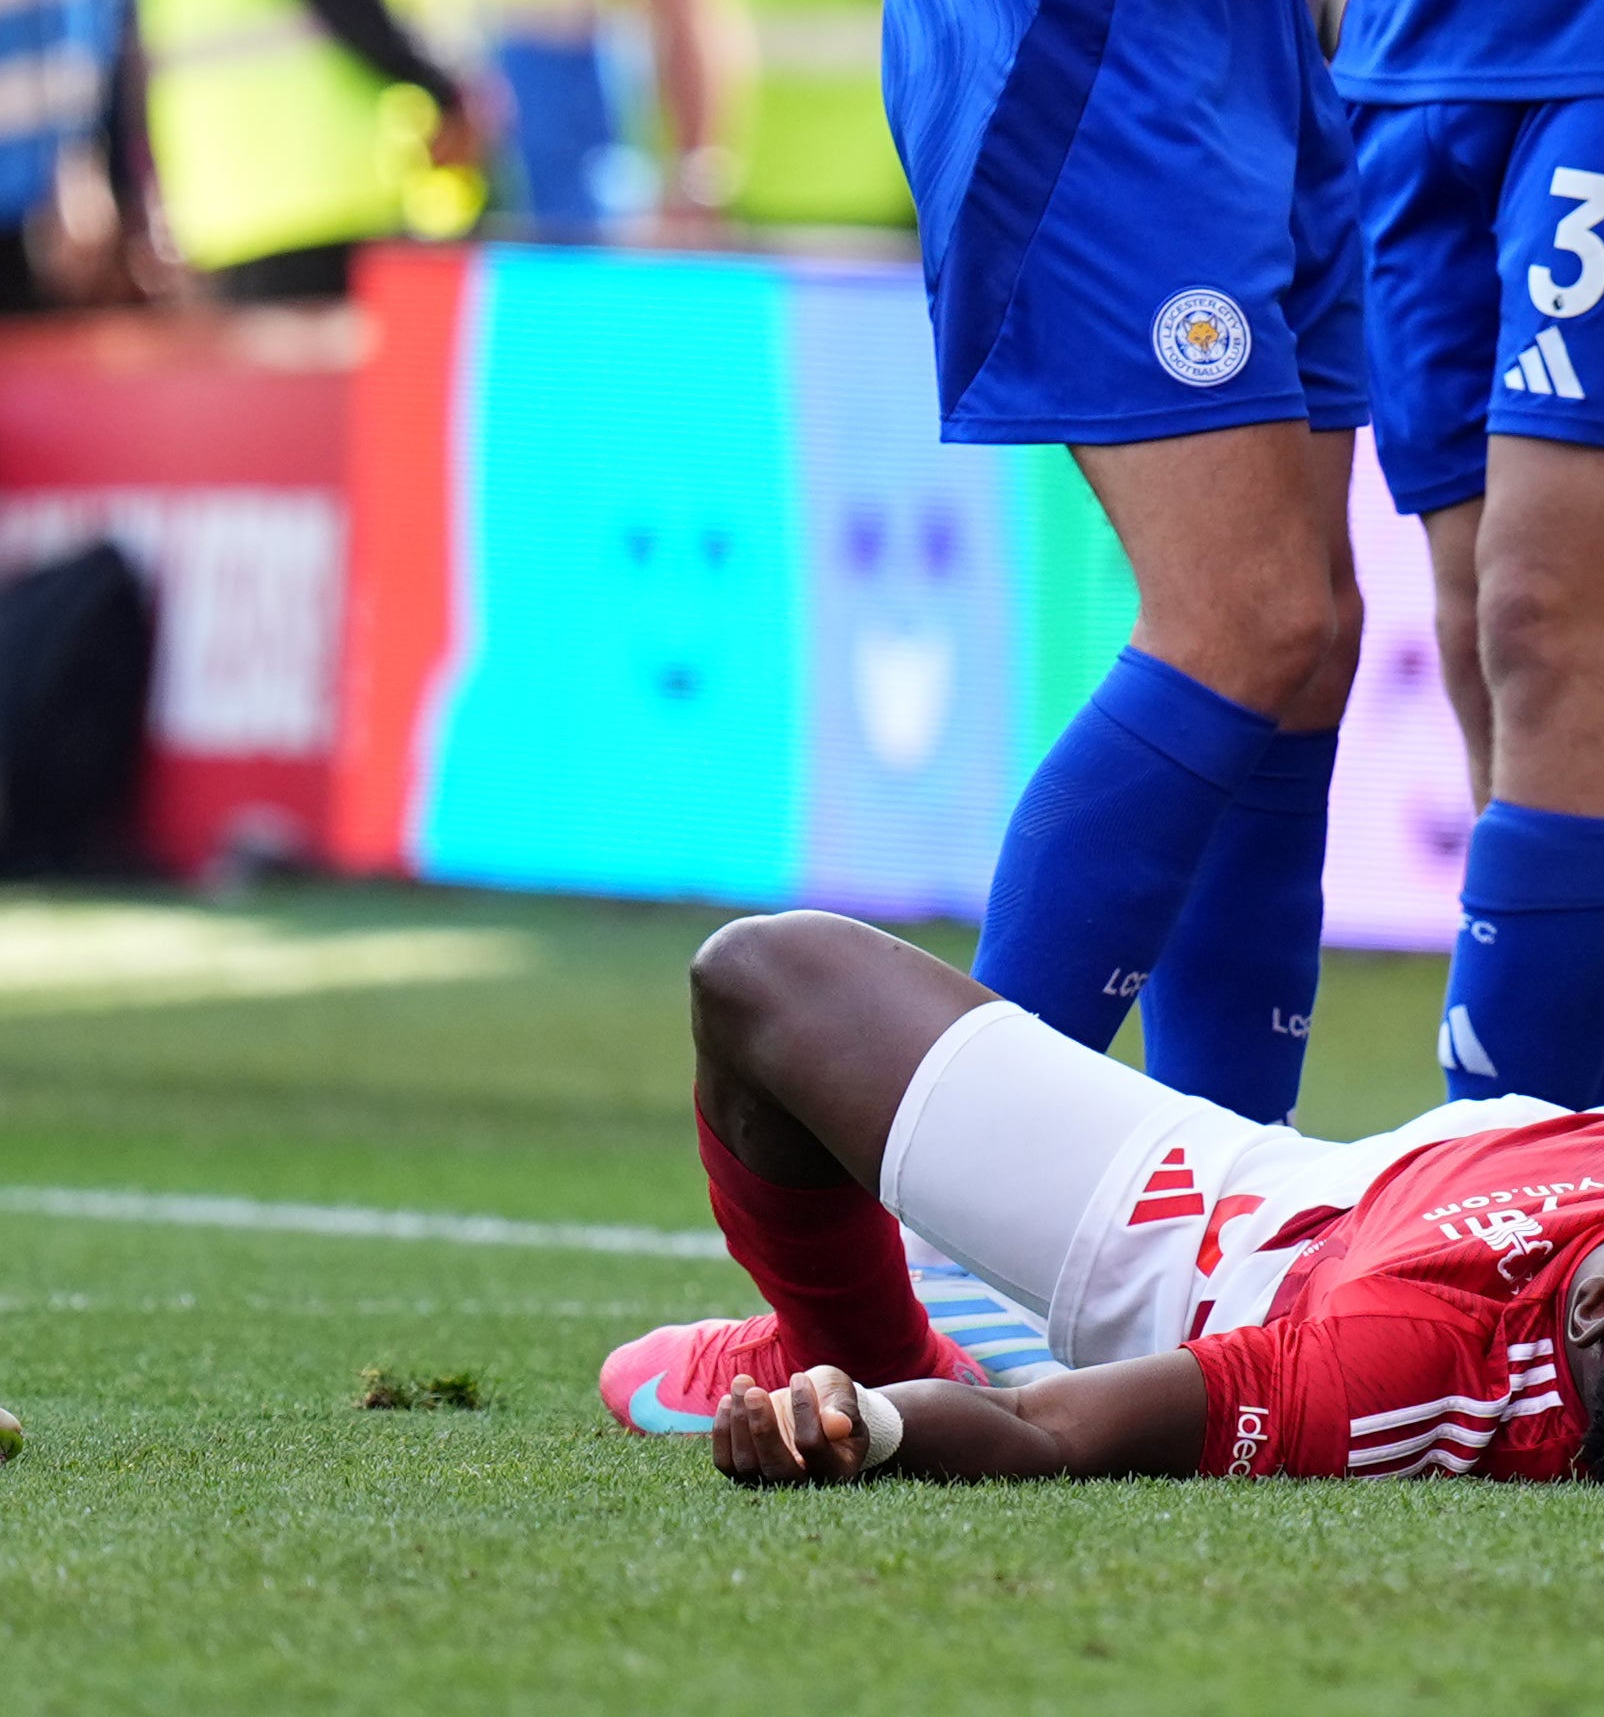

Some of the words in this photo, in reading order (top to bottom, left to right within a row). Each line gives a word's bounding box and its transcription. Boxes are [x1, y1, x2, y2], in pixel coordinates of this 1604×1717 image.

[1163, 298, 1217, 338] LEICESTER
[1218, 305, 1240, 330] CITY
[1165, 346, 1223, 376] FOOTBALL
[1223, 337, 1241, 367] CLUB
